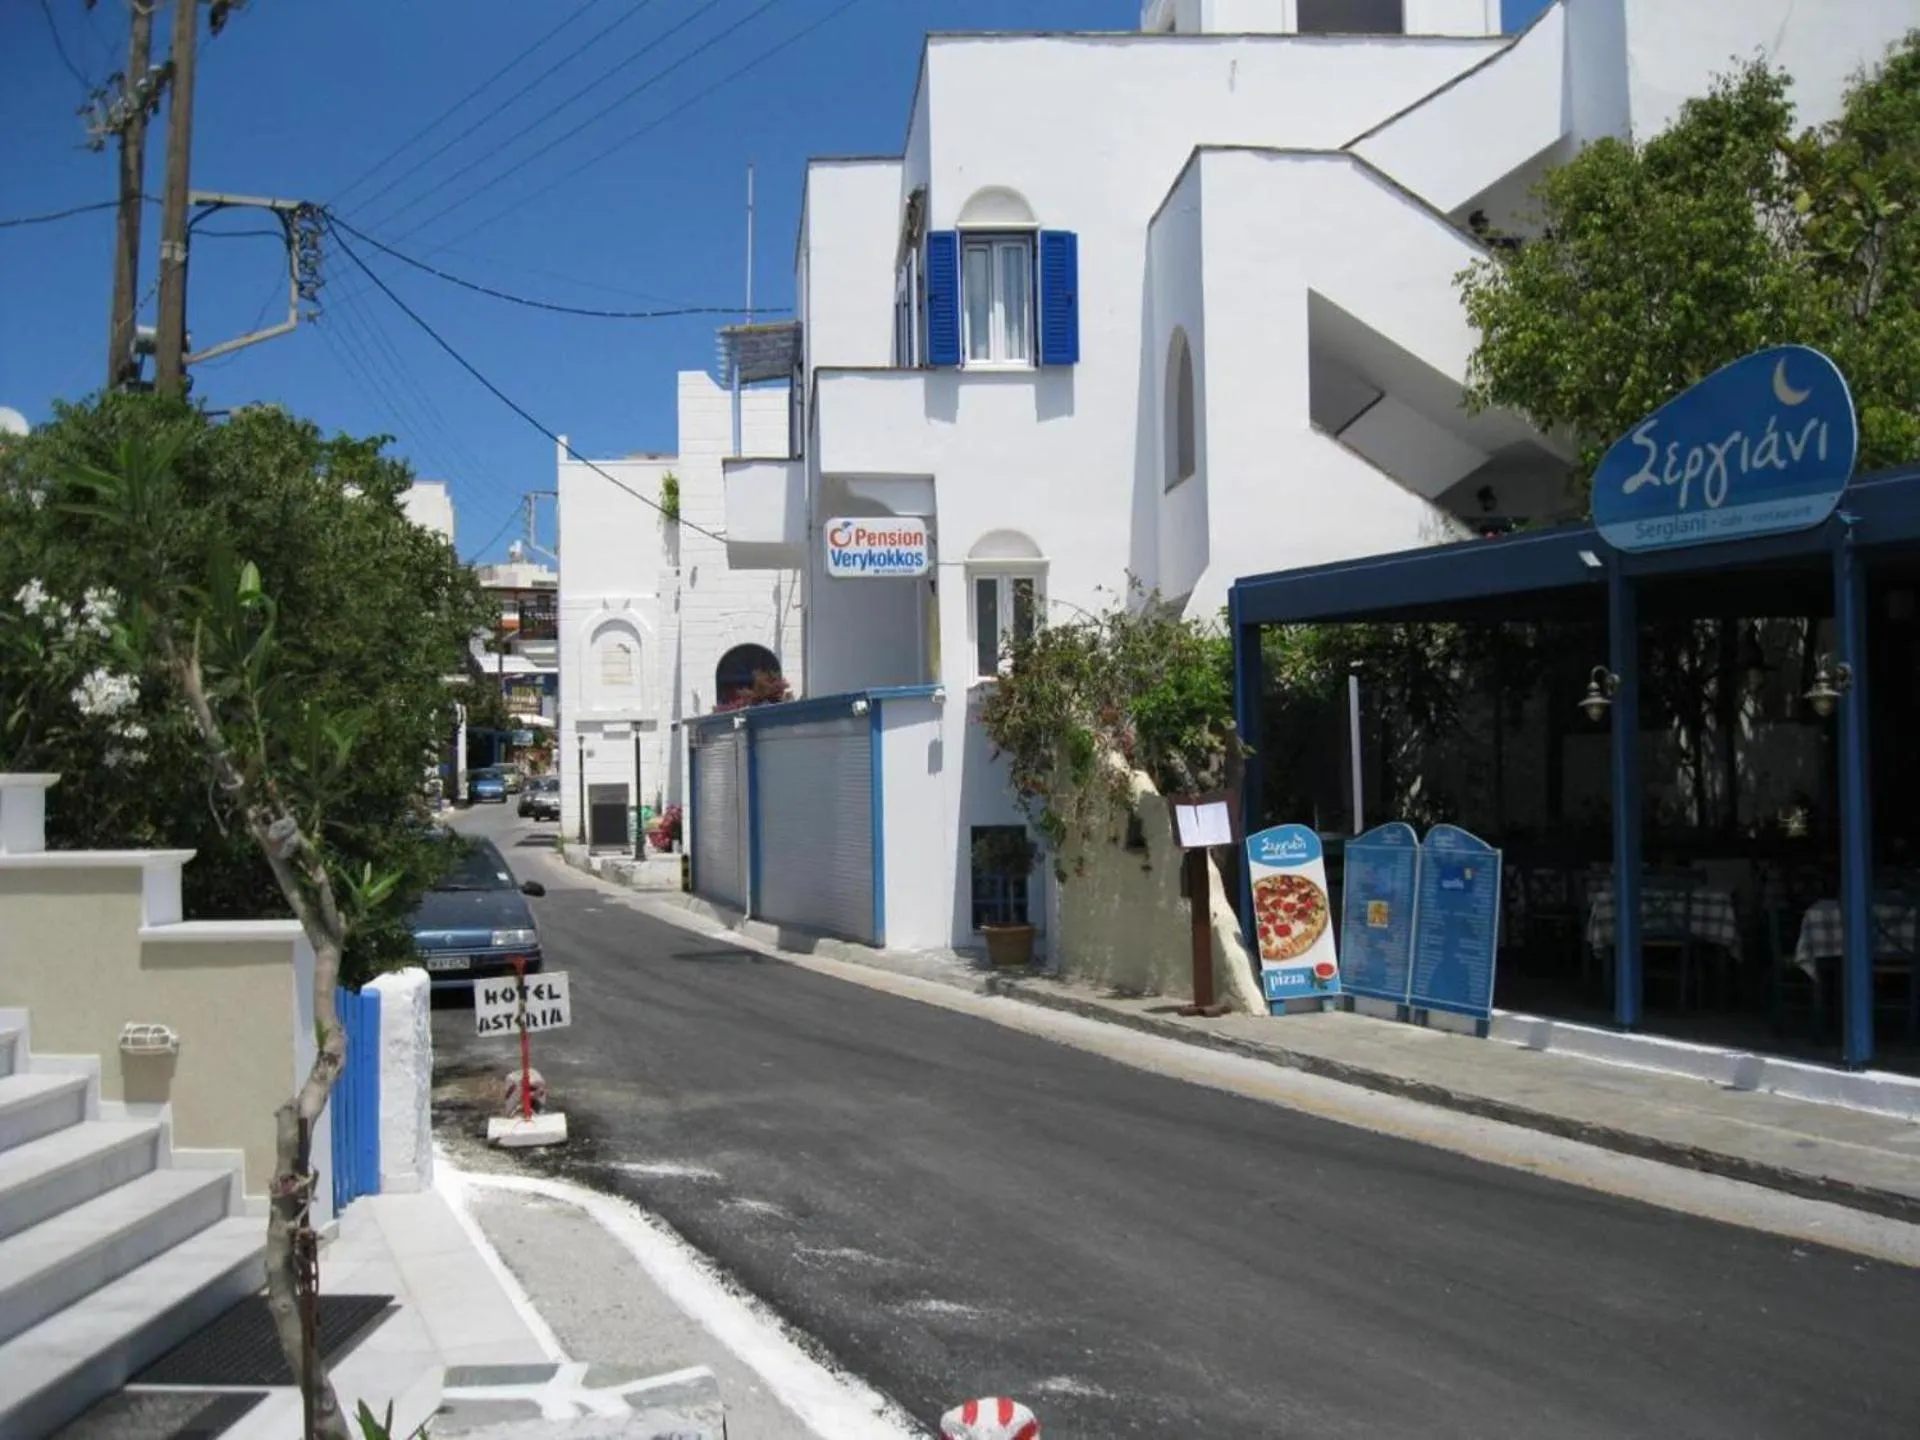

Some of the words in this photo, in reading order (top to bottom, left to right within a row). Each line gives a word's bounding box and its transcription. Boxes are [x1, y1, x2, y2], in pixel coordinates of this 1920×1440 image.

[1622, 415, 1828, 508] Σεργιάνι
[855, 528, 924, 546] Pension
[1635, 514, 1708, 539] Sergiani
[830, 548, 924, 571] Verykokkos
[1269, 970, 1306, 991] pizza
[484, 983, 561, 1005] HOTEL
